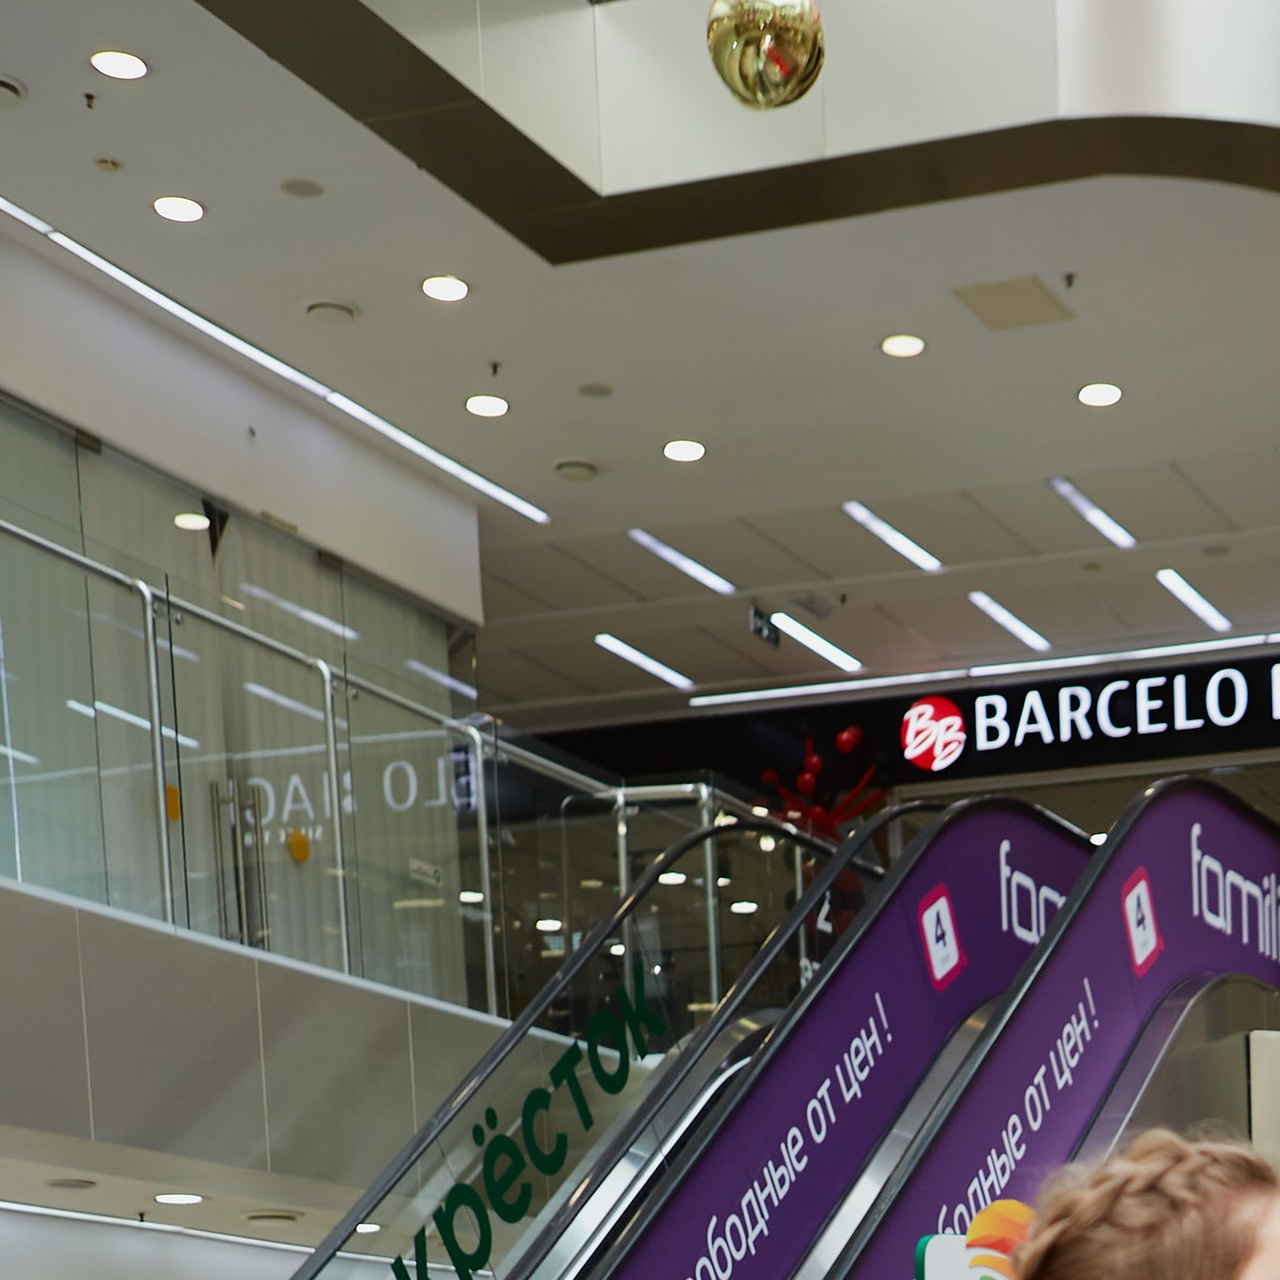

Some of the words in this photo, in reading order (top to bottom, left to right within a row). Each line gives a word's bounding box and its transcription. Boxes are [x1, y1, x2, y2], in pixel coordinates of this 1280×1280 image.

[974, 667, 1249, 752] BARCELO
[934, 909, 947, 948] 4
[1136, 893, 1147, 931] 4
[806, 1078, 838, 1144] от
[839, 992, 893, 1104] цен!
[1023, 1065, 1051, 1132] от
[1048, 977, 1100, 1090] цен!
